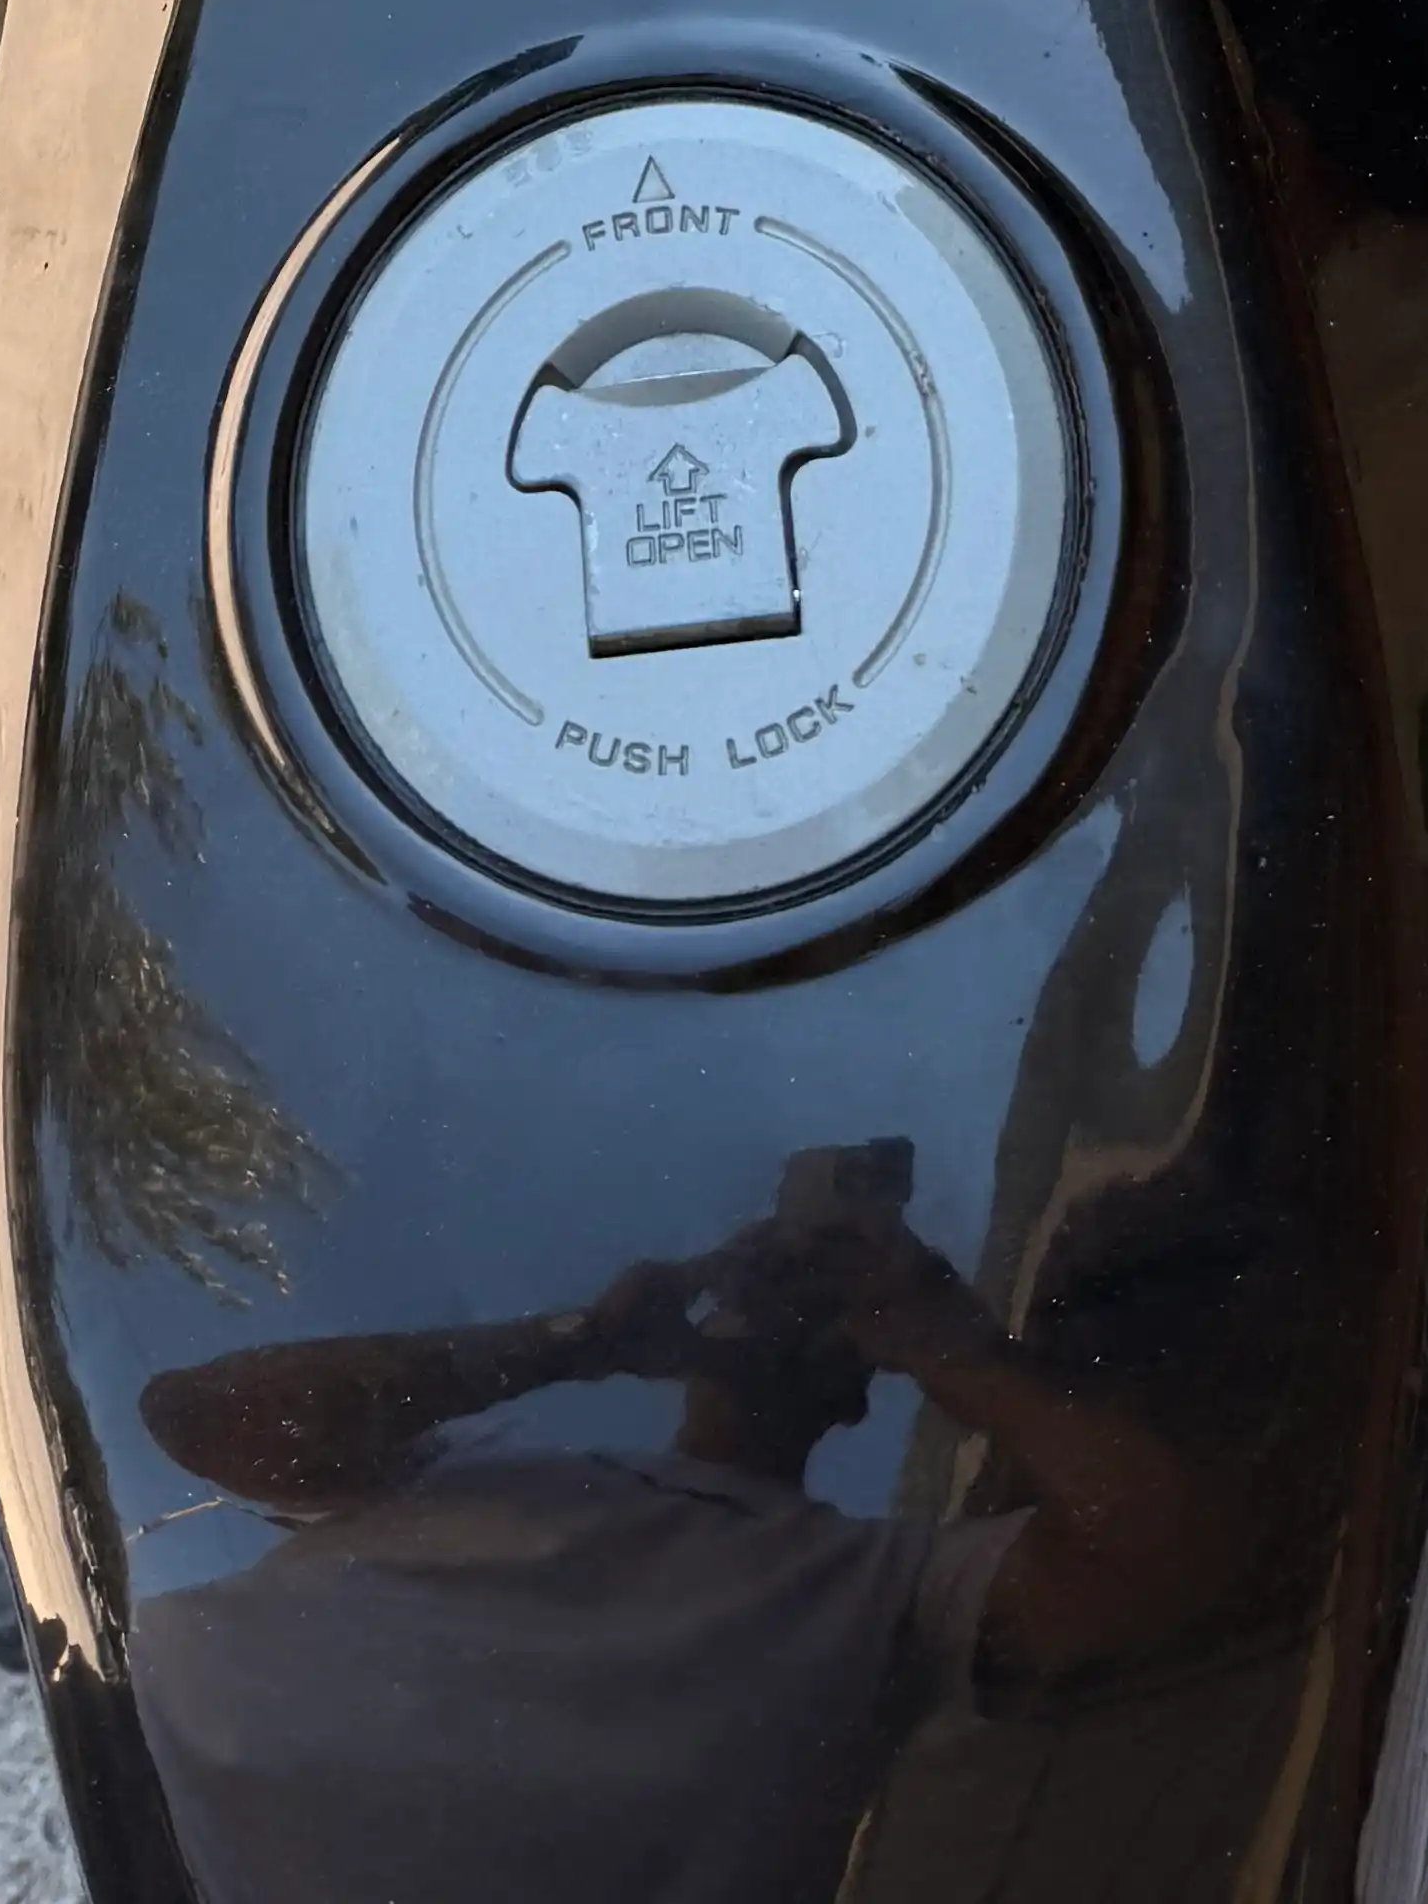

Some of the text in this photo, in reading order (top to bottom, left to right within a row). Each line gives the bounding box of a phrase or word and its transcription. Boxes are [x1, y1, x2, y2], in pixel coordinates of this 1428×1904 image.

[582, 205, 740, 251] FRONT
[636, 493, 728, 532] LIFT
[626, 525, 743, 567] OPEN
[555, 684, 855, 776] PUSH LOCK
